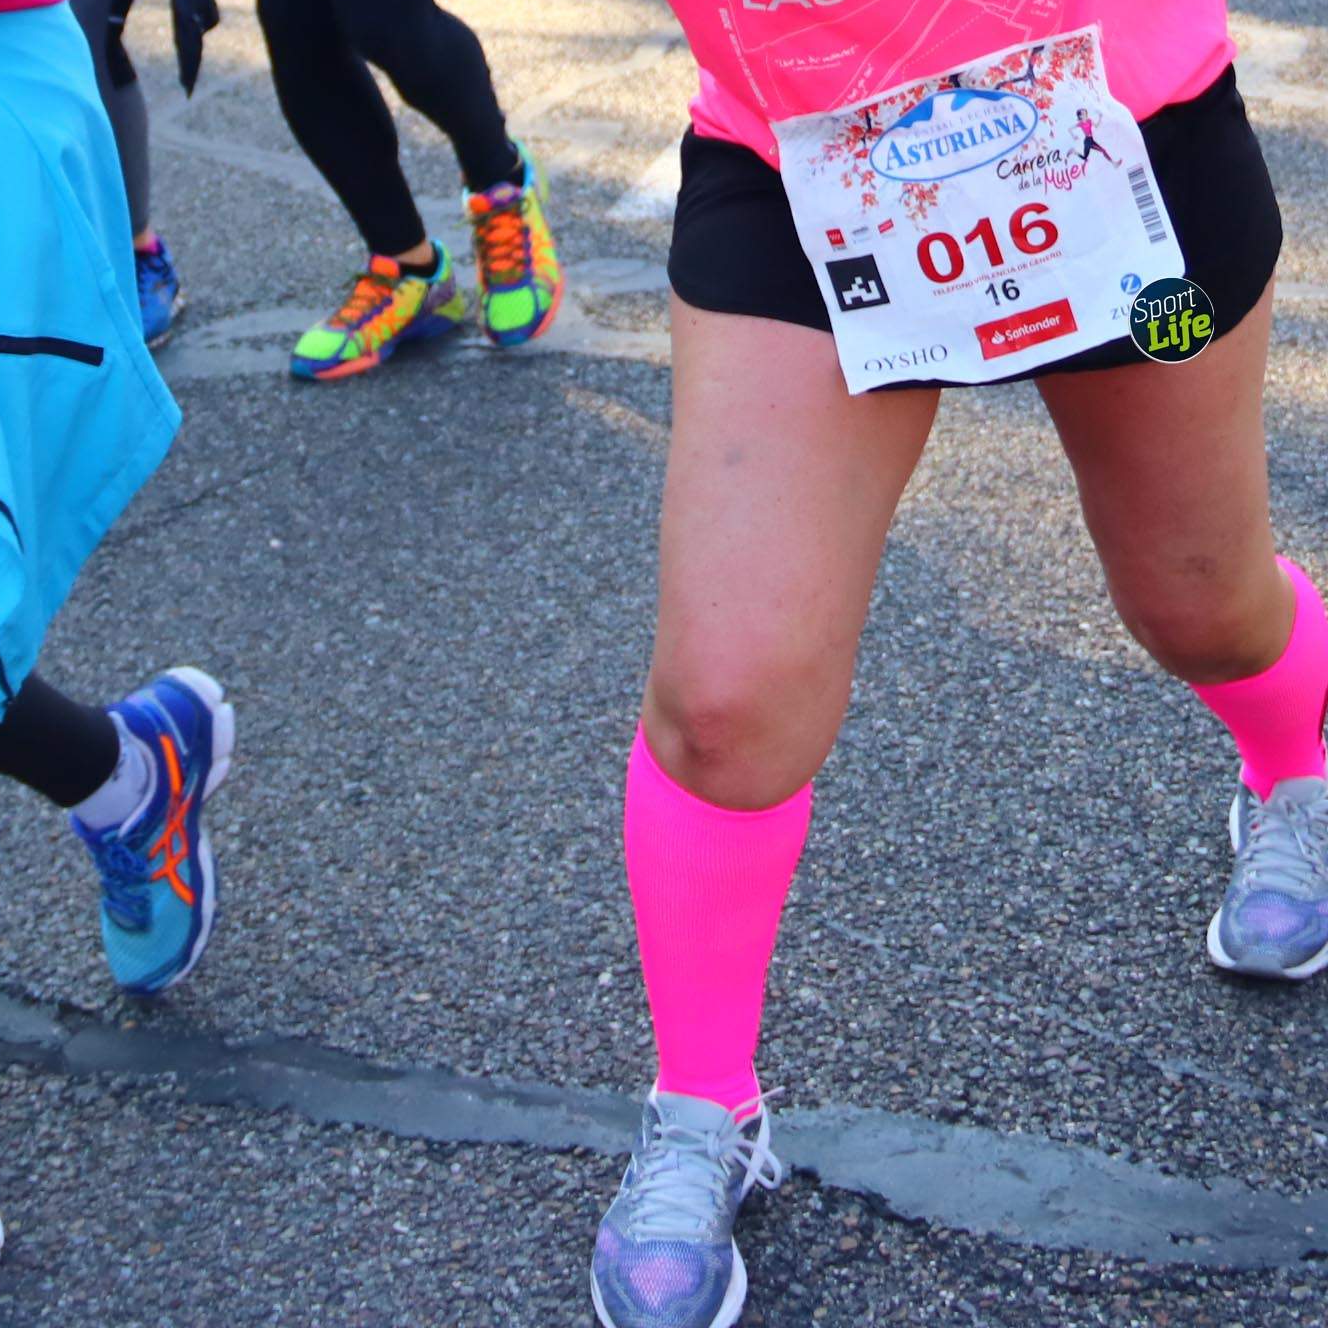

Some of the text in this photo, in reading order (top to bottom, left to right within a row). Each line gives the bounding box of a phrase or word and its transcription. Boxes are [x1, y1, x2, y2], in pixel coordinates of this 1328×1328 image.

[884, 111, 1028, 172] ASTURIANA
[996, 148, 1061, 181] Carrera
[1017, 177, 1032, 192] de
[1043, 156, 1088, 196] Mujer
[917, 202, 1059, 284] 016
[984, 278, 1021, 307] 16
[1005, 314, 1062, 342] Santander
[864, 343, 948, 372] OYSHO
